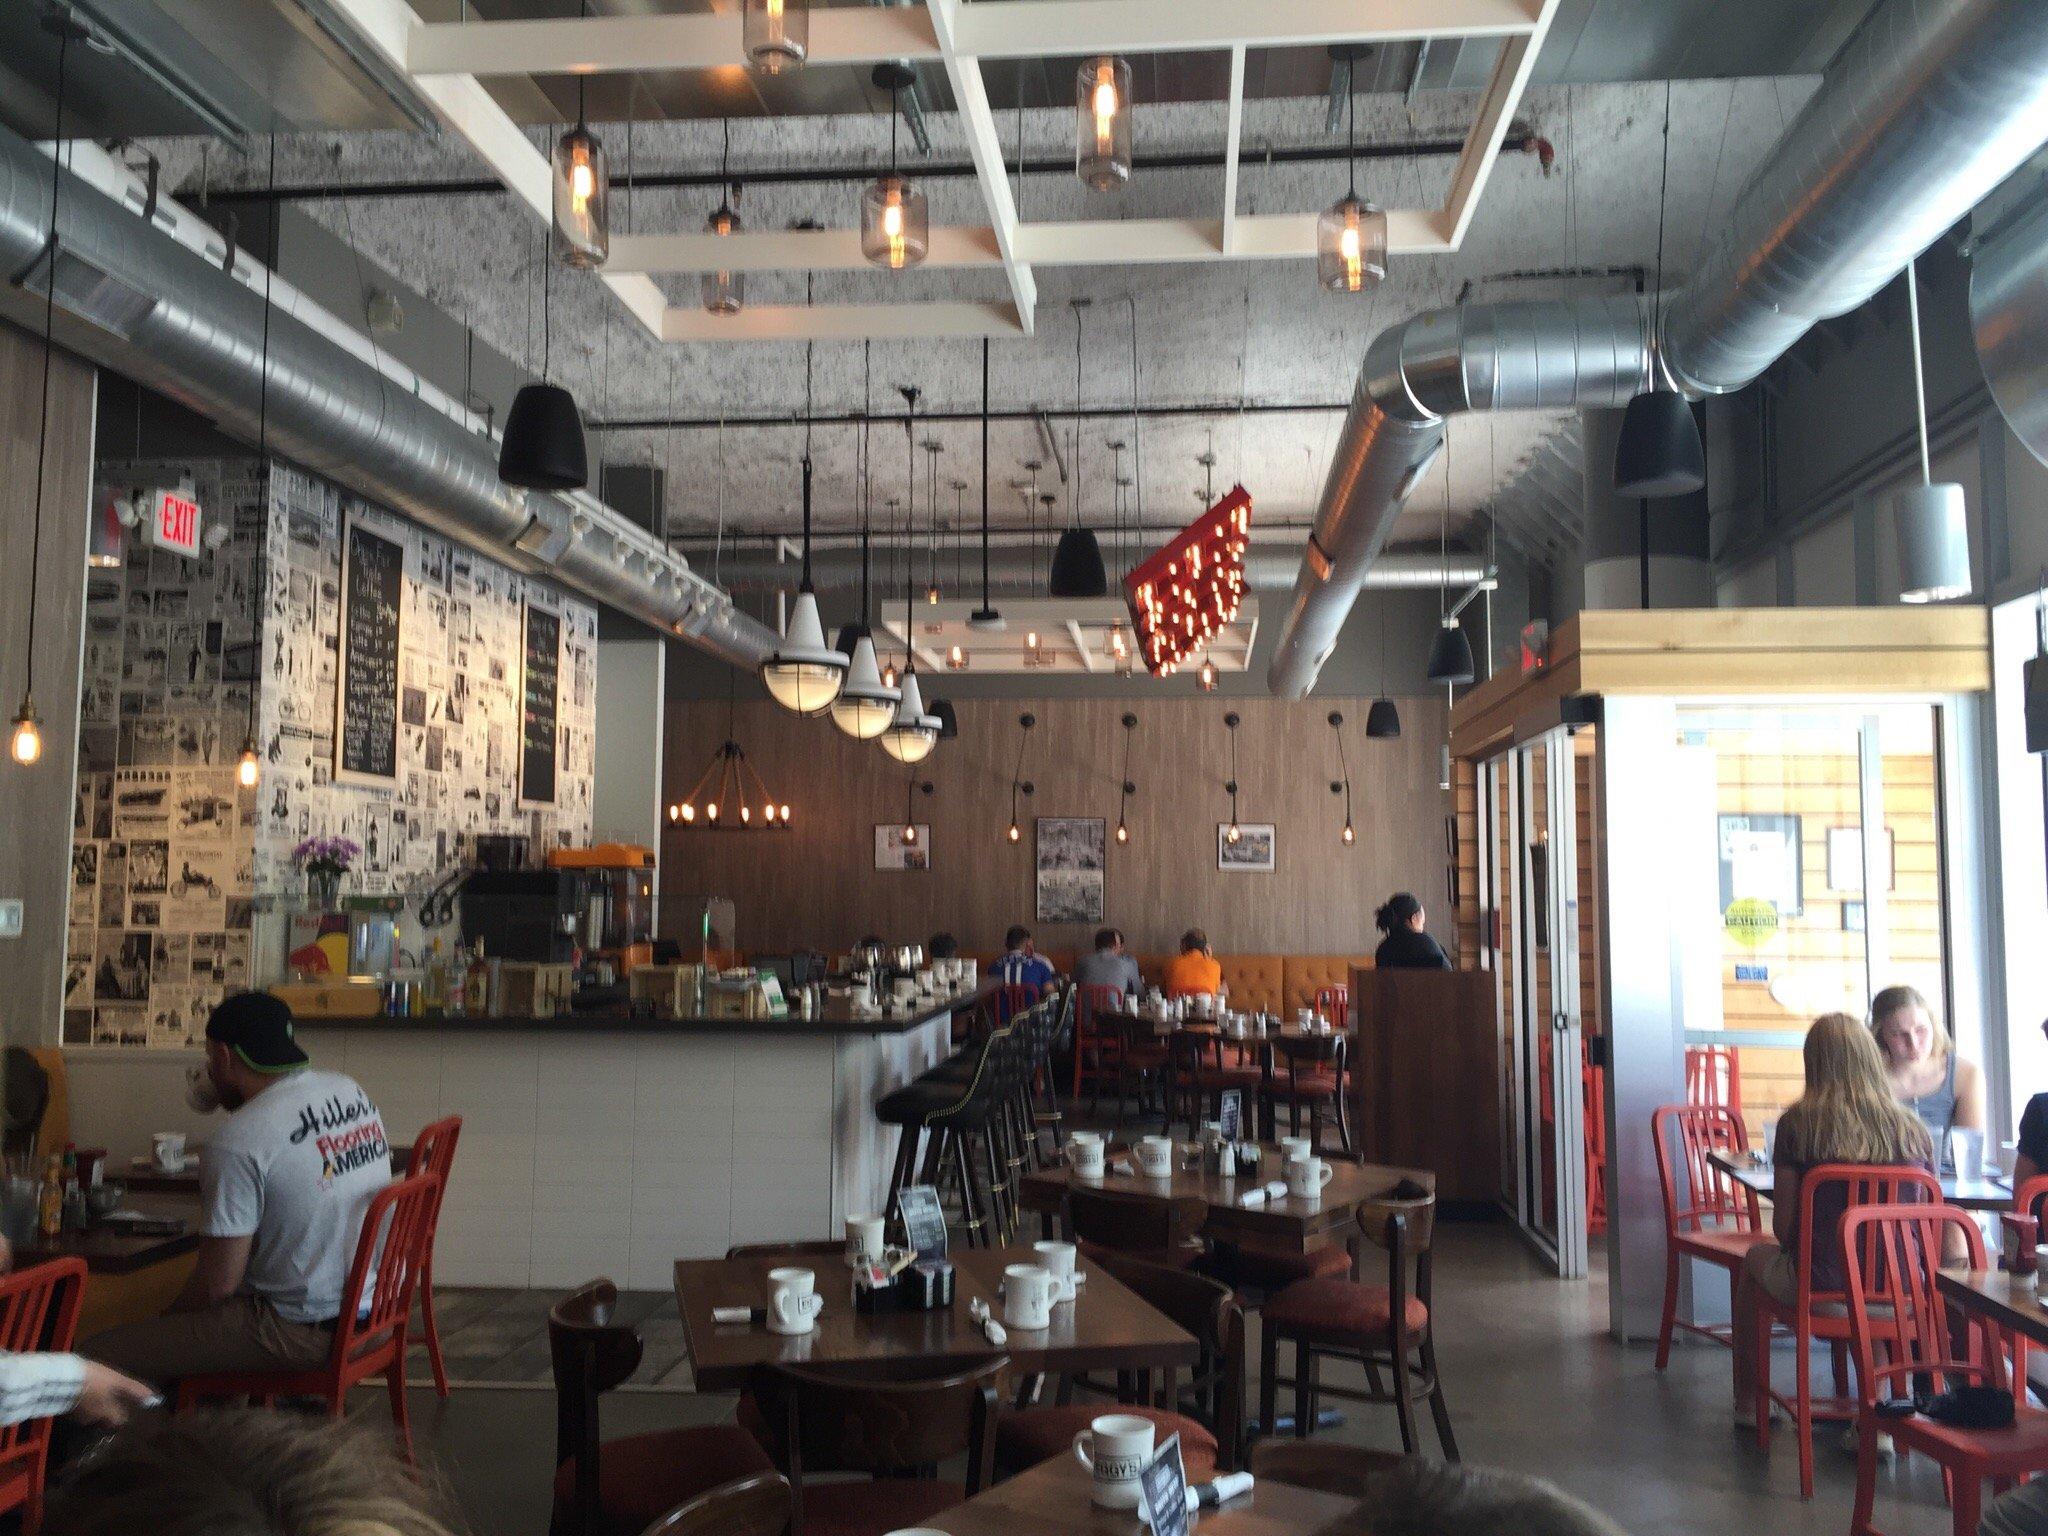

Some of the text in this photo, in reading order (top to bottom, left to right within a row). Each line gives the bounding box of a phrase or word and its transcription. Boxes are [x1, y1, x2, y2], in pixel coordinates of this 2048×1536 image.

[163, 496, 196, 547] EXIT
[316, 1119, 383, 1159] Flooring
[322, 1136, 388, 1178] AMERICA
